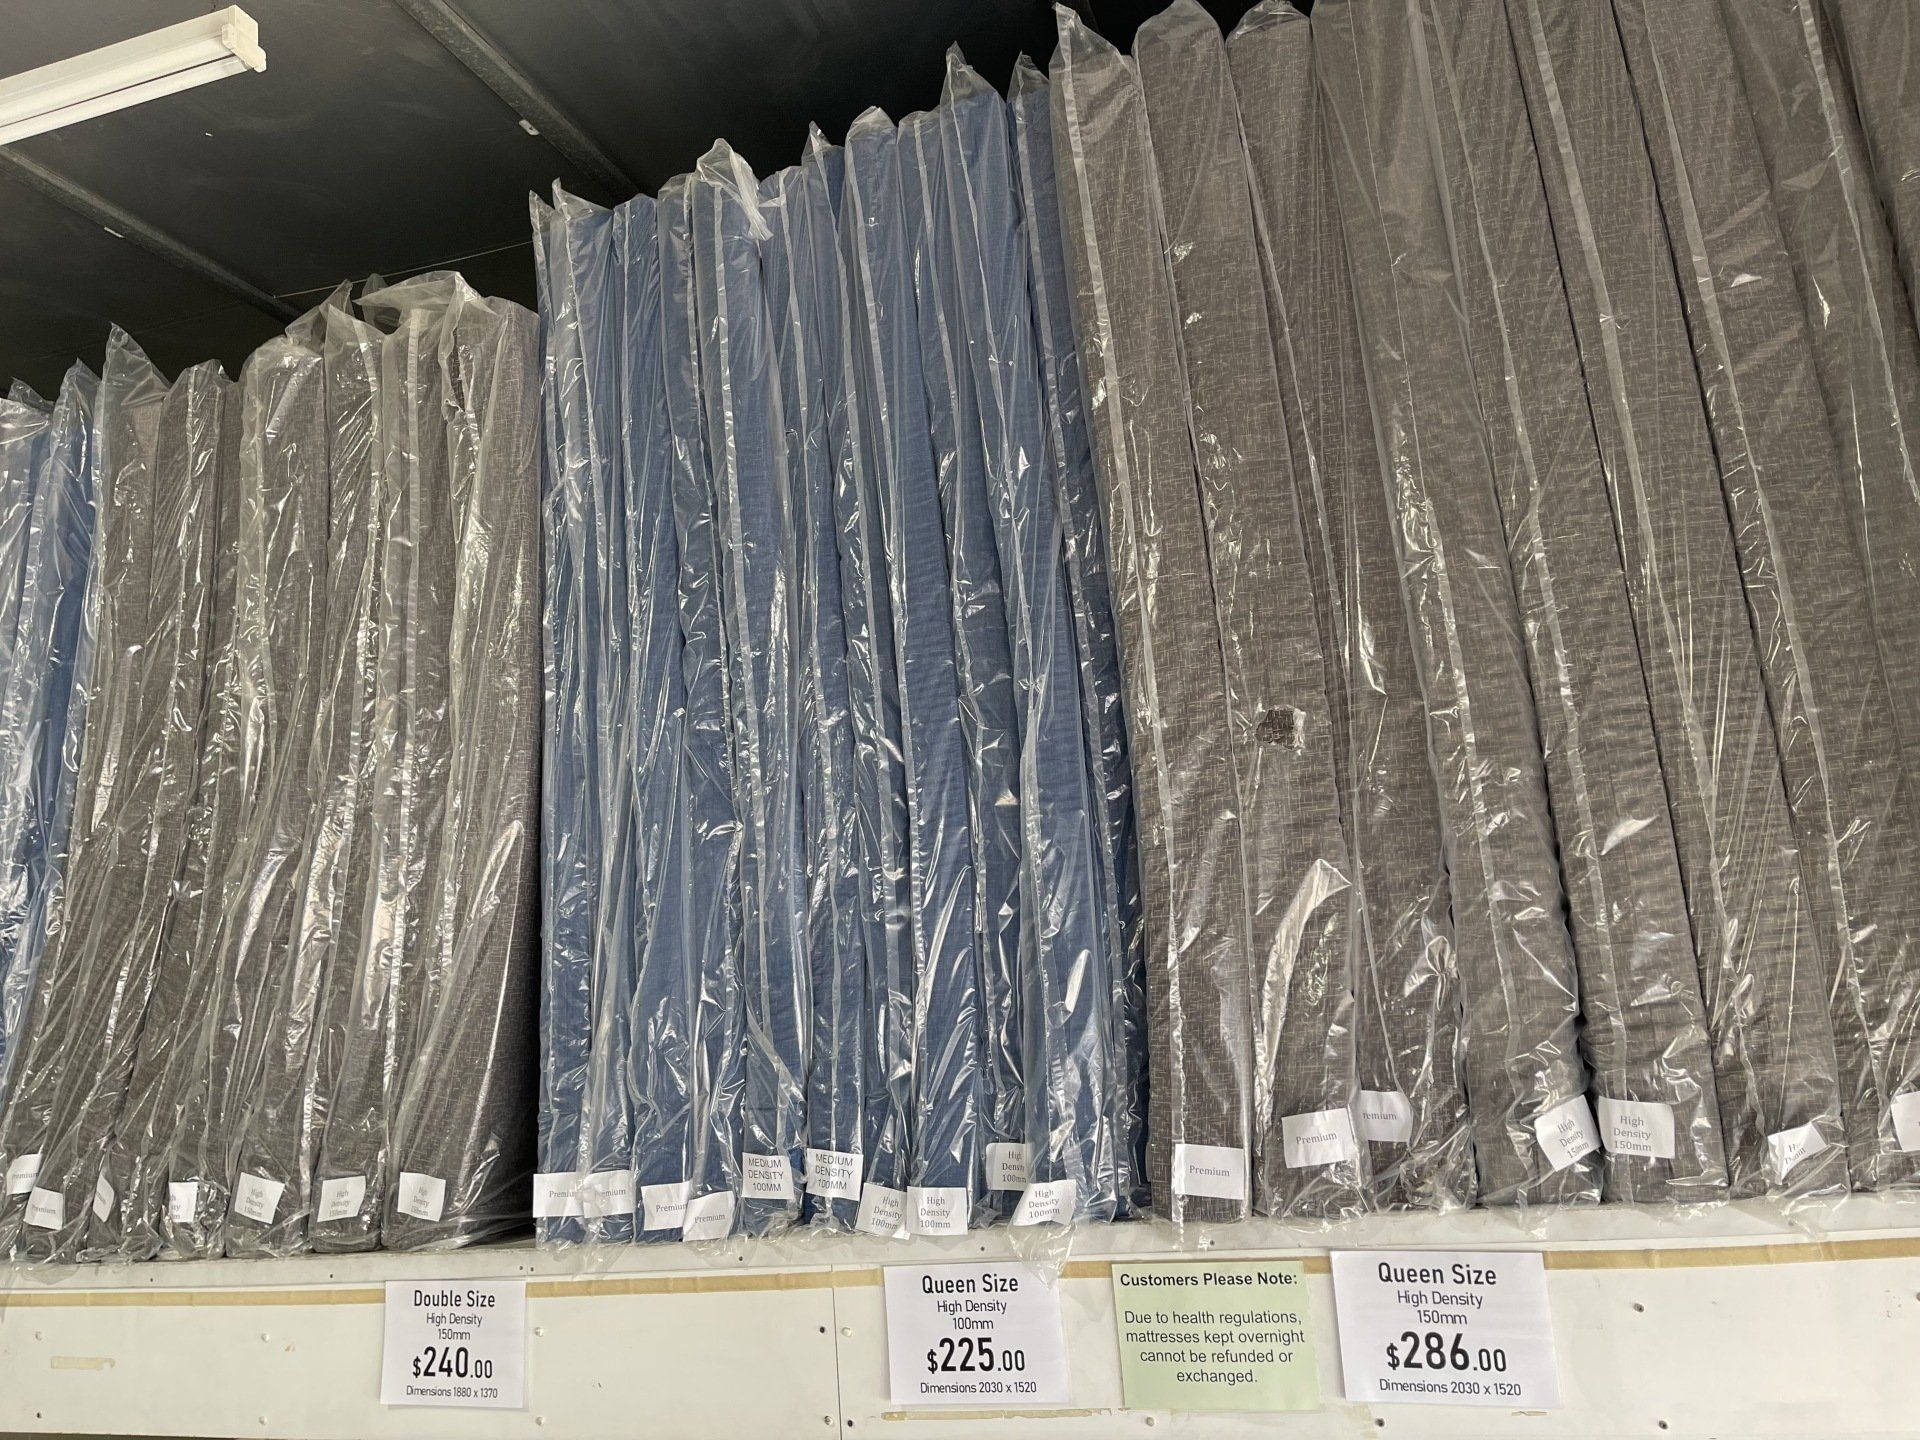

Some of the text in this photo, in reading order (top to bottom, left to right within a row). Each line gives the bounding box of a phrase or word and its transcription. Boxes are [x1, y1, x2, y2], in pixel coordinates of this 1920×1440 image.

[1363, 1110, 1397, 1121] remium
[1620, 1115, 1644, 1127] High
[1557, 1119, 1575, 1133] High
[1295, 1132, 1338, 1145] Premium
[1560, 1129, 1584, 1148] Density
[1613, 1128, 1651, 1140] Density
[1614, 1140, 1652, 1152] 150mm
[749, 1158, 782, 1168] MEDIUM
[816, 1153, 853, 1167] MEDIUM
[748, 1170, 784, 1180] DENSITY
[815, 1165, 854, 1179] DENSITY
[1189, 1165, 1230, 1177] Premium
[753, 1183, 782, 1192] 100MM
[818, 1179, 847, 1190] 100MM
[1034, 1189, 1054, 1199] High
[882, 1196, 899, 1208] High
[927, 1196, 945, 1206] High
[1028, 1198, 1060, 1209] Density
[694, 1213, 725, 1224] Premium
[873, 1206, 902, 1219] Density
[920, 1208, 951, 1218] Density
[1029, 1208, 1061, 1219] 100mm
[920, 1220, 951, 1228] 100mm
[1120, 1272, 1298, 1286] Customers Please Note:
[1378, 1262, 1497, 1285] Queen Size
[922, 1273, 1019, 1294] Queen Size
[414, 1289, 496, 1307] Double Size
[1397, 1290, 1483, 1309] High Density
[937, 1299, 1007, 1315] High Density
[426, 1313, 483, 1327] High Density
[953, 1317, 994, 1330] 100mm
[1124, 1310, 1302, 1327] Due to health regulations,
[1417, 1310, 1468, 1325] 150mm
[438, 1328, 471, 1340] 150mm
[1126, 1330, 1305, 1346] mattresses kept overnight
[927, 1337, 1025, 1374] $225.00
[1140, 1349, 1293, 1362] cannot be refunded or
[1386, 1331, 1507, 1372] $286.00
[412, 1346, 493, 1379] $240.00
[1177, 1369, 1258, 1386] exchanged.
[406, 1385, 498, 1398] Dimensions 1880 x 1370
[920, 1381, 1037, 1393] Dimensions 2030 x 1520
[1379, 1379, 1521, 1395] Dimensions 2030 x 1520
